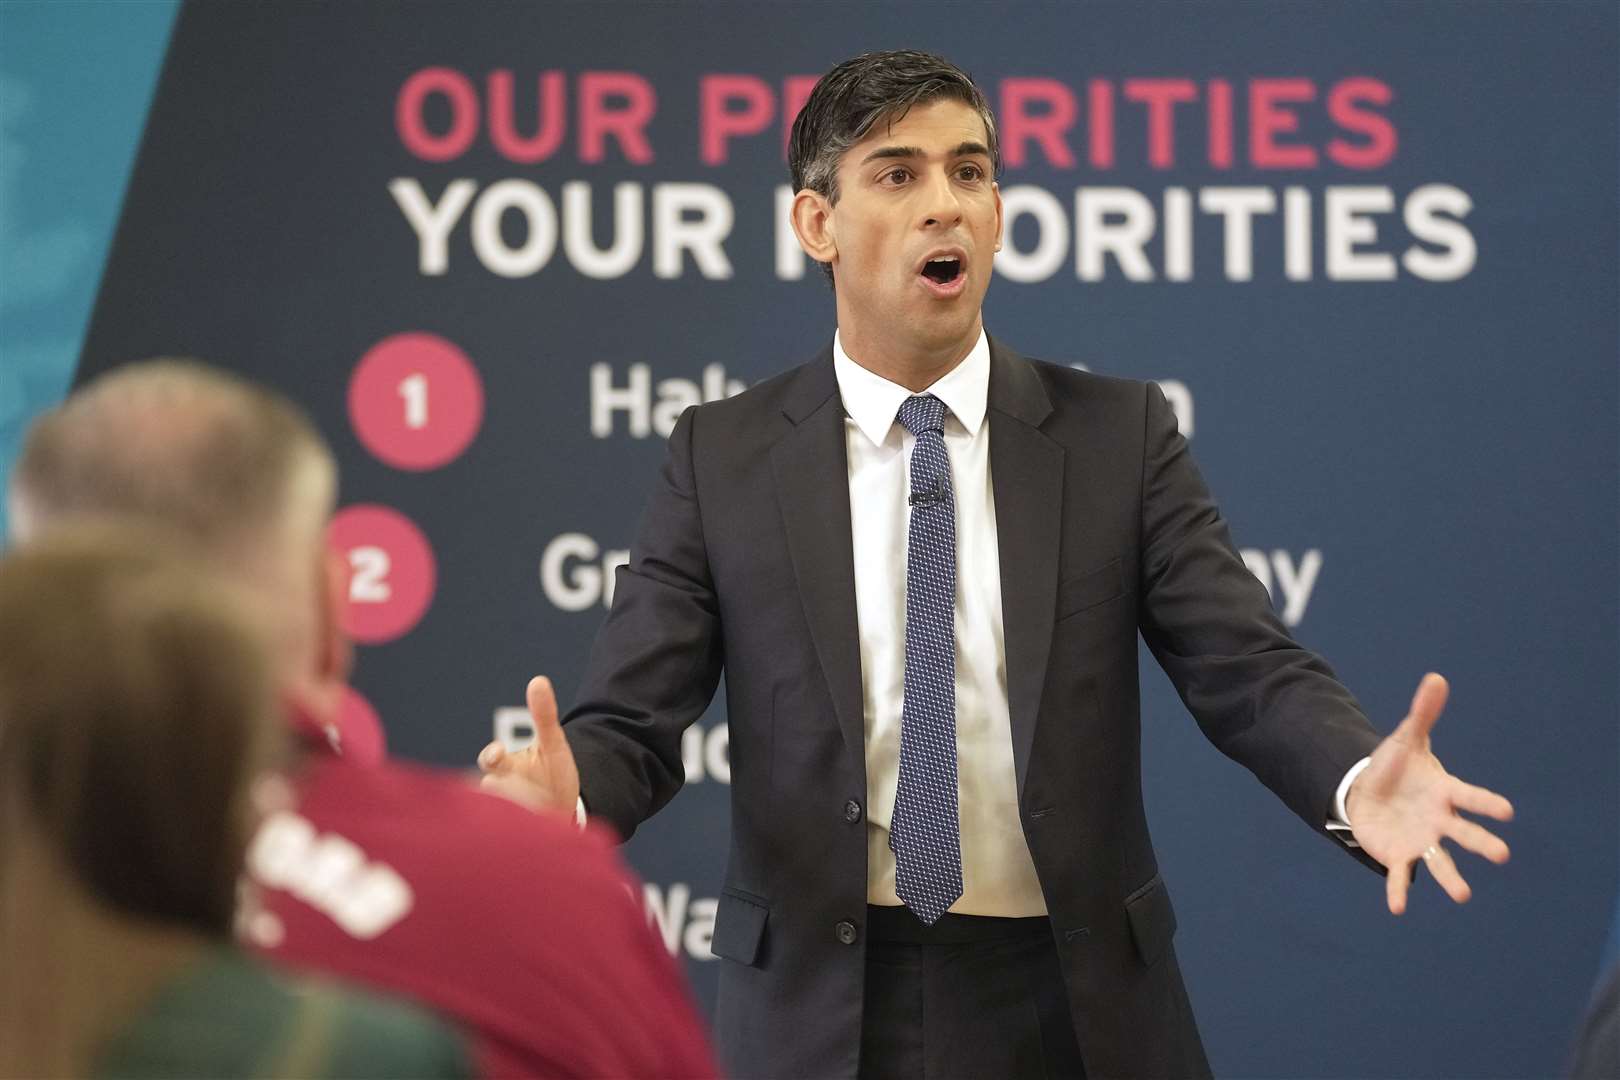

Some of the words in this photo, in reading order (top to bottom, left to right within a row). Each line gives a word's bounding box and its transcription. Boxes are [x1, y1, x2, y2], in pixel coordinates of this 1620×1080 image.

[396, 68, 655, 164] OUR
[701, 74, 1397, 169] PRITIES
[390, 178, 734, 280] YOUR
[774, 183, 1477, 283] ORITIES
[398, 373, 429, 430] 1
[346, 545, 392, 603] 2
